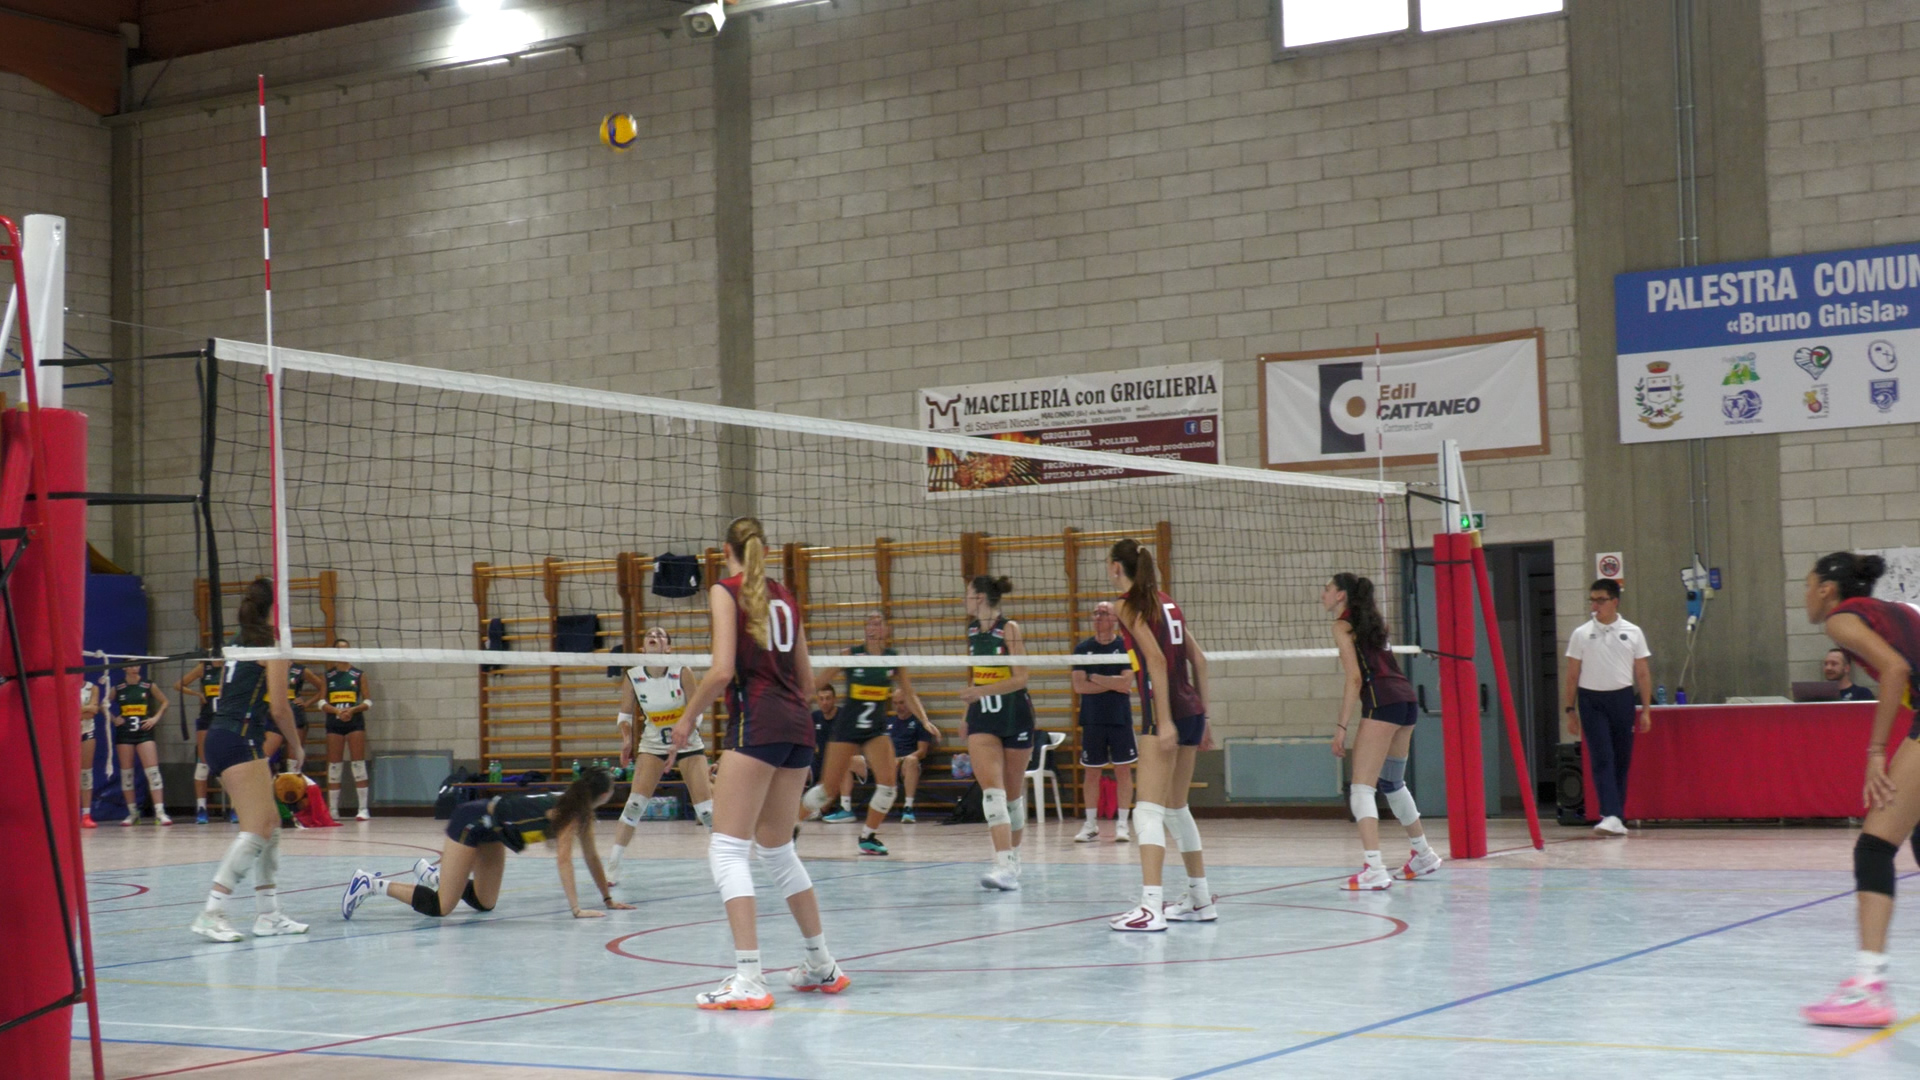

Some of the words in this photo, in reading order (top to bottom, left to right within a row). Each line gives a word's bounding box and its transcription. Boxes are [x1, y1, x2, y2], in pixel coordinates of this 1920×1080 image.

[1646, 266, 1798, 314] PALESTRA
[1726, 310, 1811, 336] «Bruno
[1817, 299, 1909, 328] Ghisla»
[964, 387, 1071, 416] MACELLERIA
[1075, 388, 1106, 406] con
[1111, 374, 1218, 404] GRIGLIERIA
[1379, 383, 1416, 401] Edil
[1376, 396, 1481, 421] CATTANEO
[965, 423, 974, 433] di
[976, 420, 1008, 432] Salvetti
[1010, 417, 1040, 430] Nicola
[1041, 429, 1092, 441] GRIGLIERIA
[1098, 435, 1140, 447] POLLERIA
[1135, 444, 1161, 453] nostra
[1162, 440, 1216, 452] produzione)
[1087, 467, 1125, 478] ASPORTO
[1162, 602, 1184, 645] 6
[855, 701, 878, 725] 2
[128, 715, 141, 732] 3
